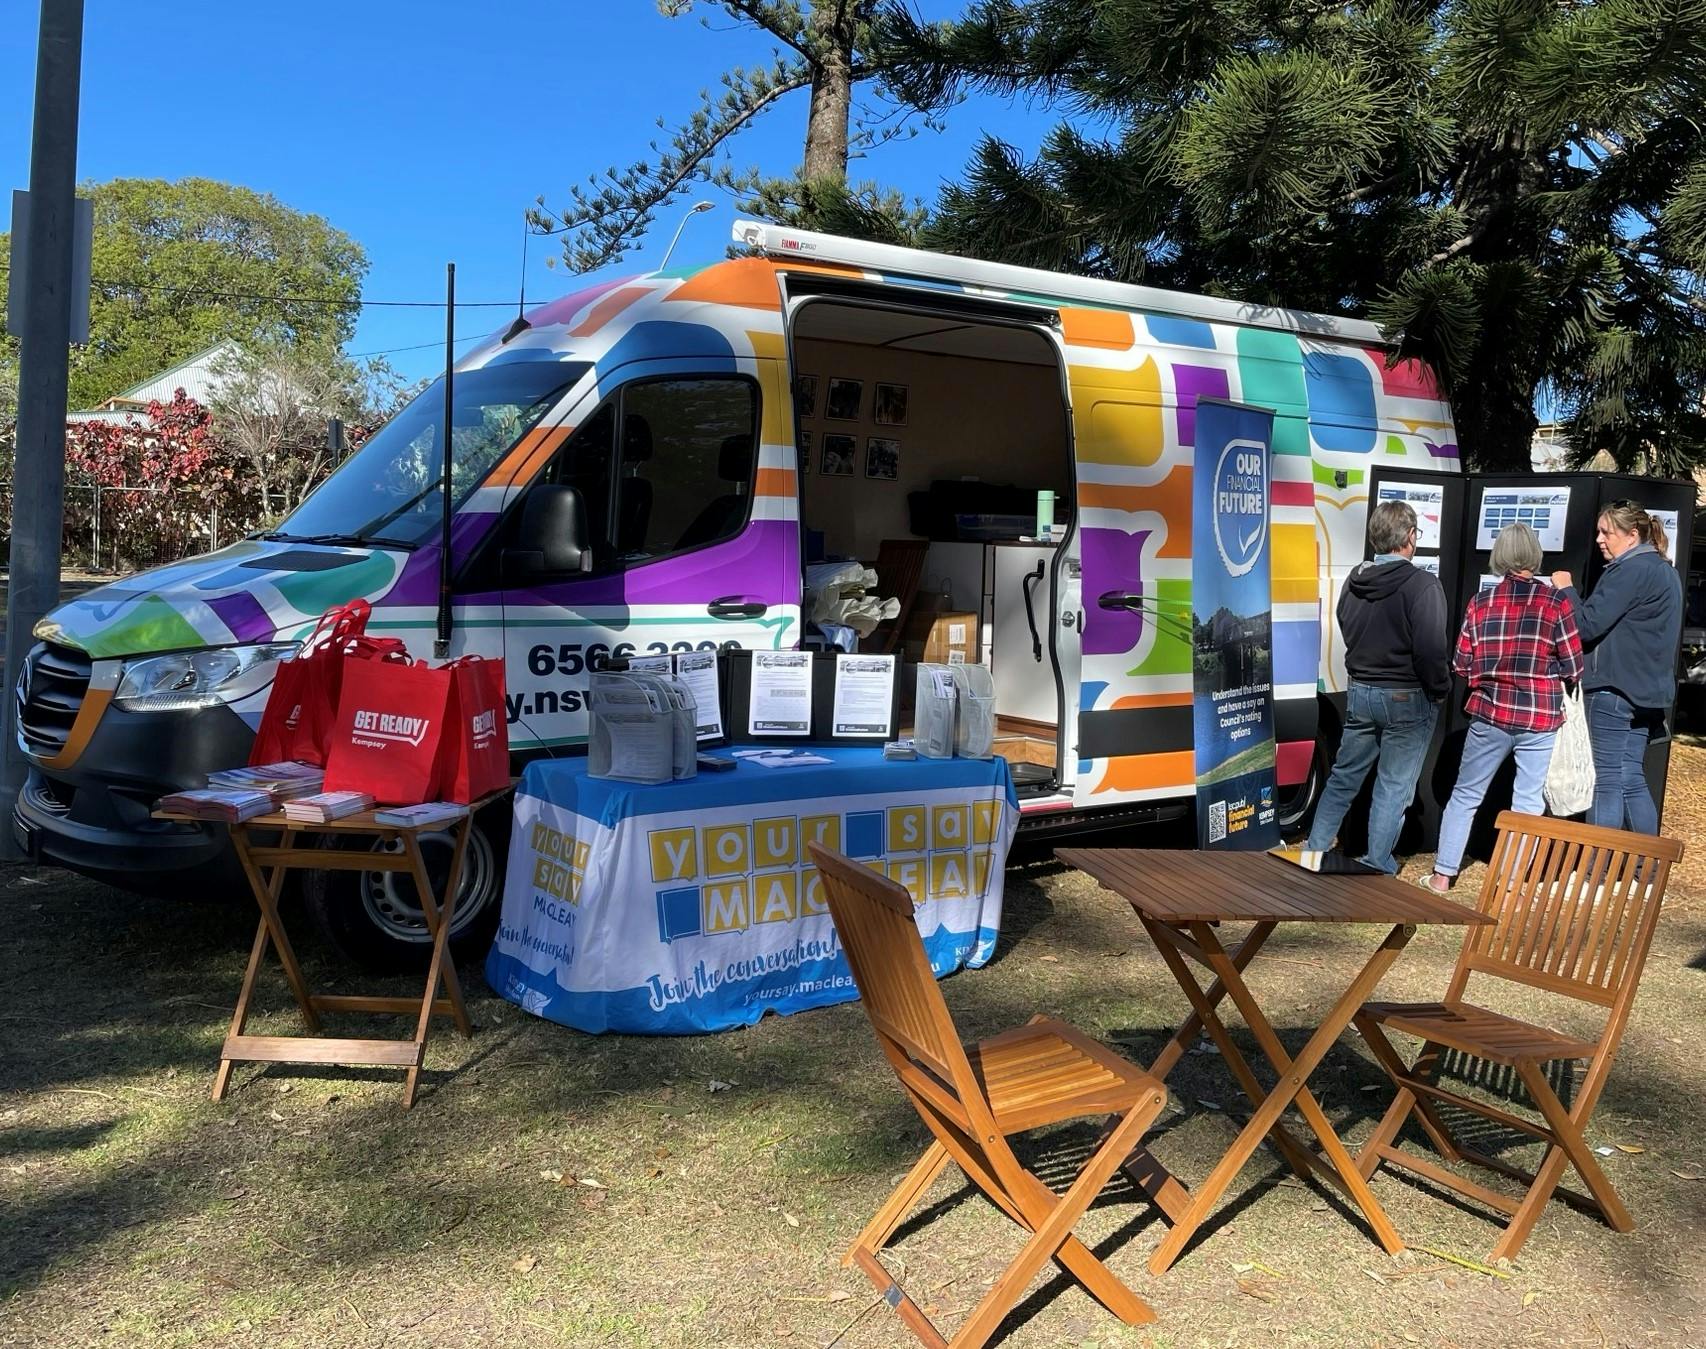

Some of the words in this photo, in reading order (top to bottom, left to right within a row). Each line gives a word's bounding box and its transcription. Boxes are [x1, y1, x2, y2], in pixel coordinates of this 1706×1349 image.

[1236, 453, 1261, 476] OUR
[1226, 475, 1262, 491] FINANCIAL
[1219, 492, 1262, 514] FUTURE
[1212, 686, 1243, 701] Understand
[1243, 685, 1252, 695] the
[1252, 682, 1270, 694] issues
[1217, 703, 1228, 714] and
[1227, 701, 1242, 712] have
[1246, 699, 1257, 710] say
[354, 710, 379, 731] GET
[380, 713, 422, 737] READY
[1220, 714, 1245, 728] Council's
[1245, 710, 1262, 722] rating
[1231, 727, 1251, 742] options
[536, 829, 587, 865] your
[540, 864, 582, 902] say
[645, 973, 693, 1009] Join
[693, 960, 723, 998] the
[725, 927, 838, 984] conversation!
[743, 975, 858, 1006] yoursay.maclea
